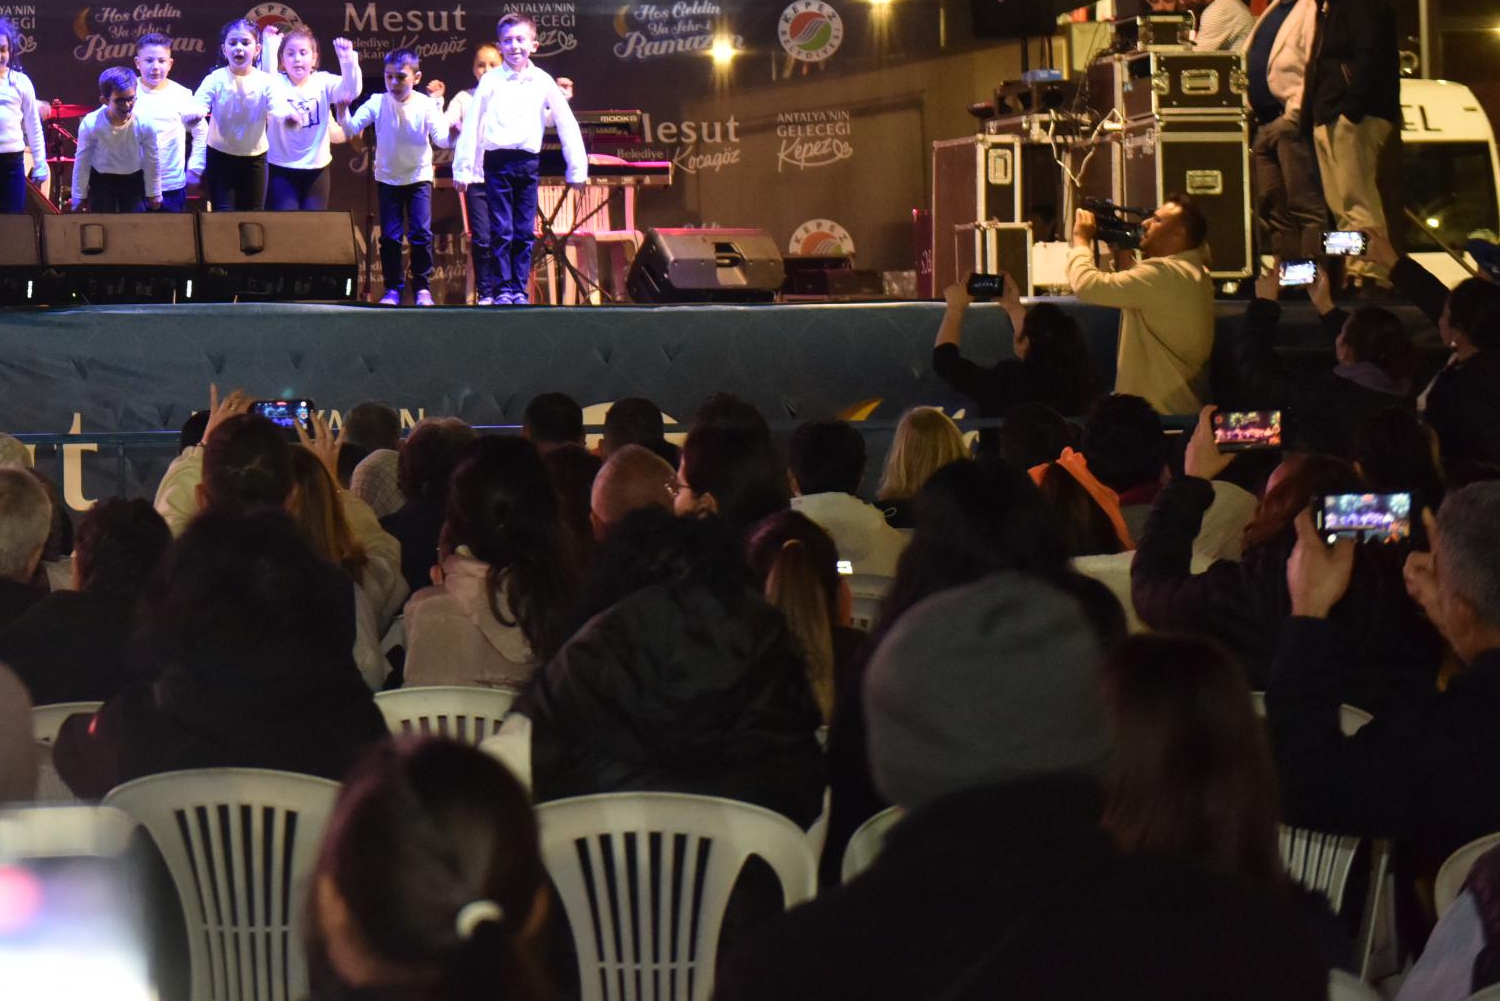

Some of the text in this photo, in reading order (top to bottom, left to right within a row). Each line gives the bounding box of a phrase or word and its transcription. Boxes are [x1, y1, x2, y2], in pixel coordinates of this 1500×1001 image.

[132, 3, 182, 21] Geldin
[254, 4, 299, 25] EPEZ
[343, 2, 467, 31] Mesut
[671, 0, 721, 19] Geldin
[783, 1, 837, 24] KEPEZ
[352, 37, 390, 49] elediye
[613, 31, 746, 59] Ramazn
[777, 111, 850, 123] ANTALYA'NIN
[672, 145, 740, 174] Kocagöz
[778, 138, 835, 173] Kepez
[794, 221, 848, 245] KEPEZ
